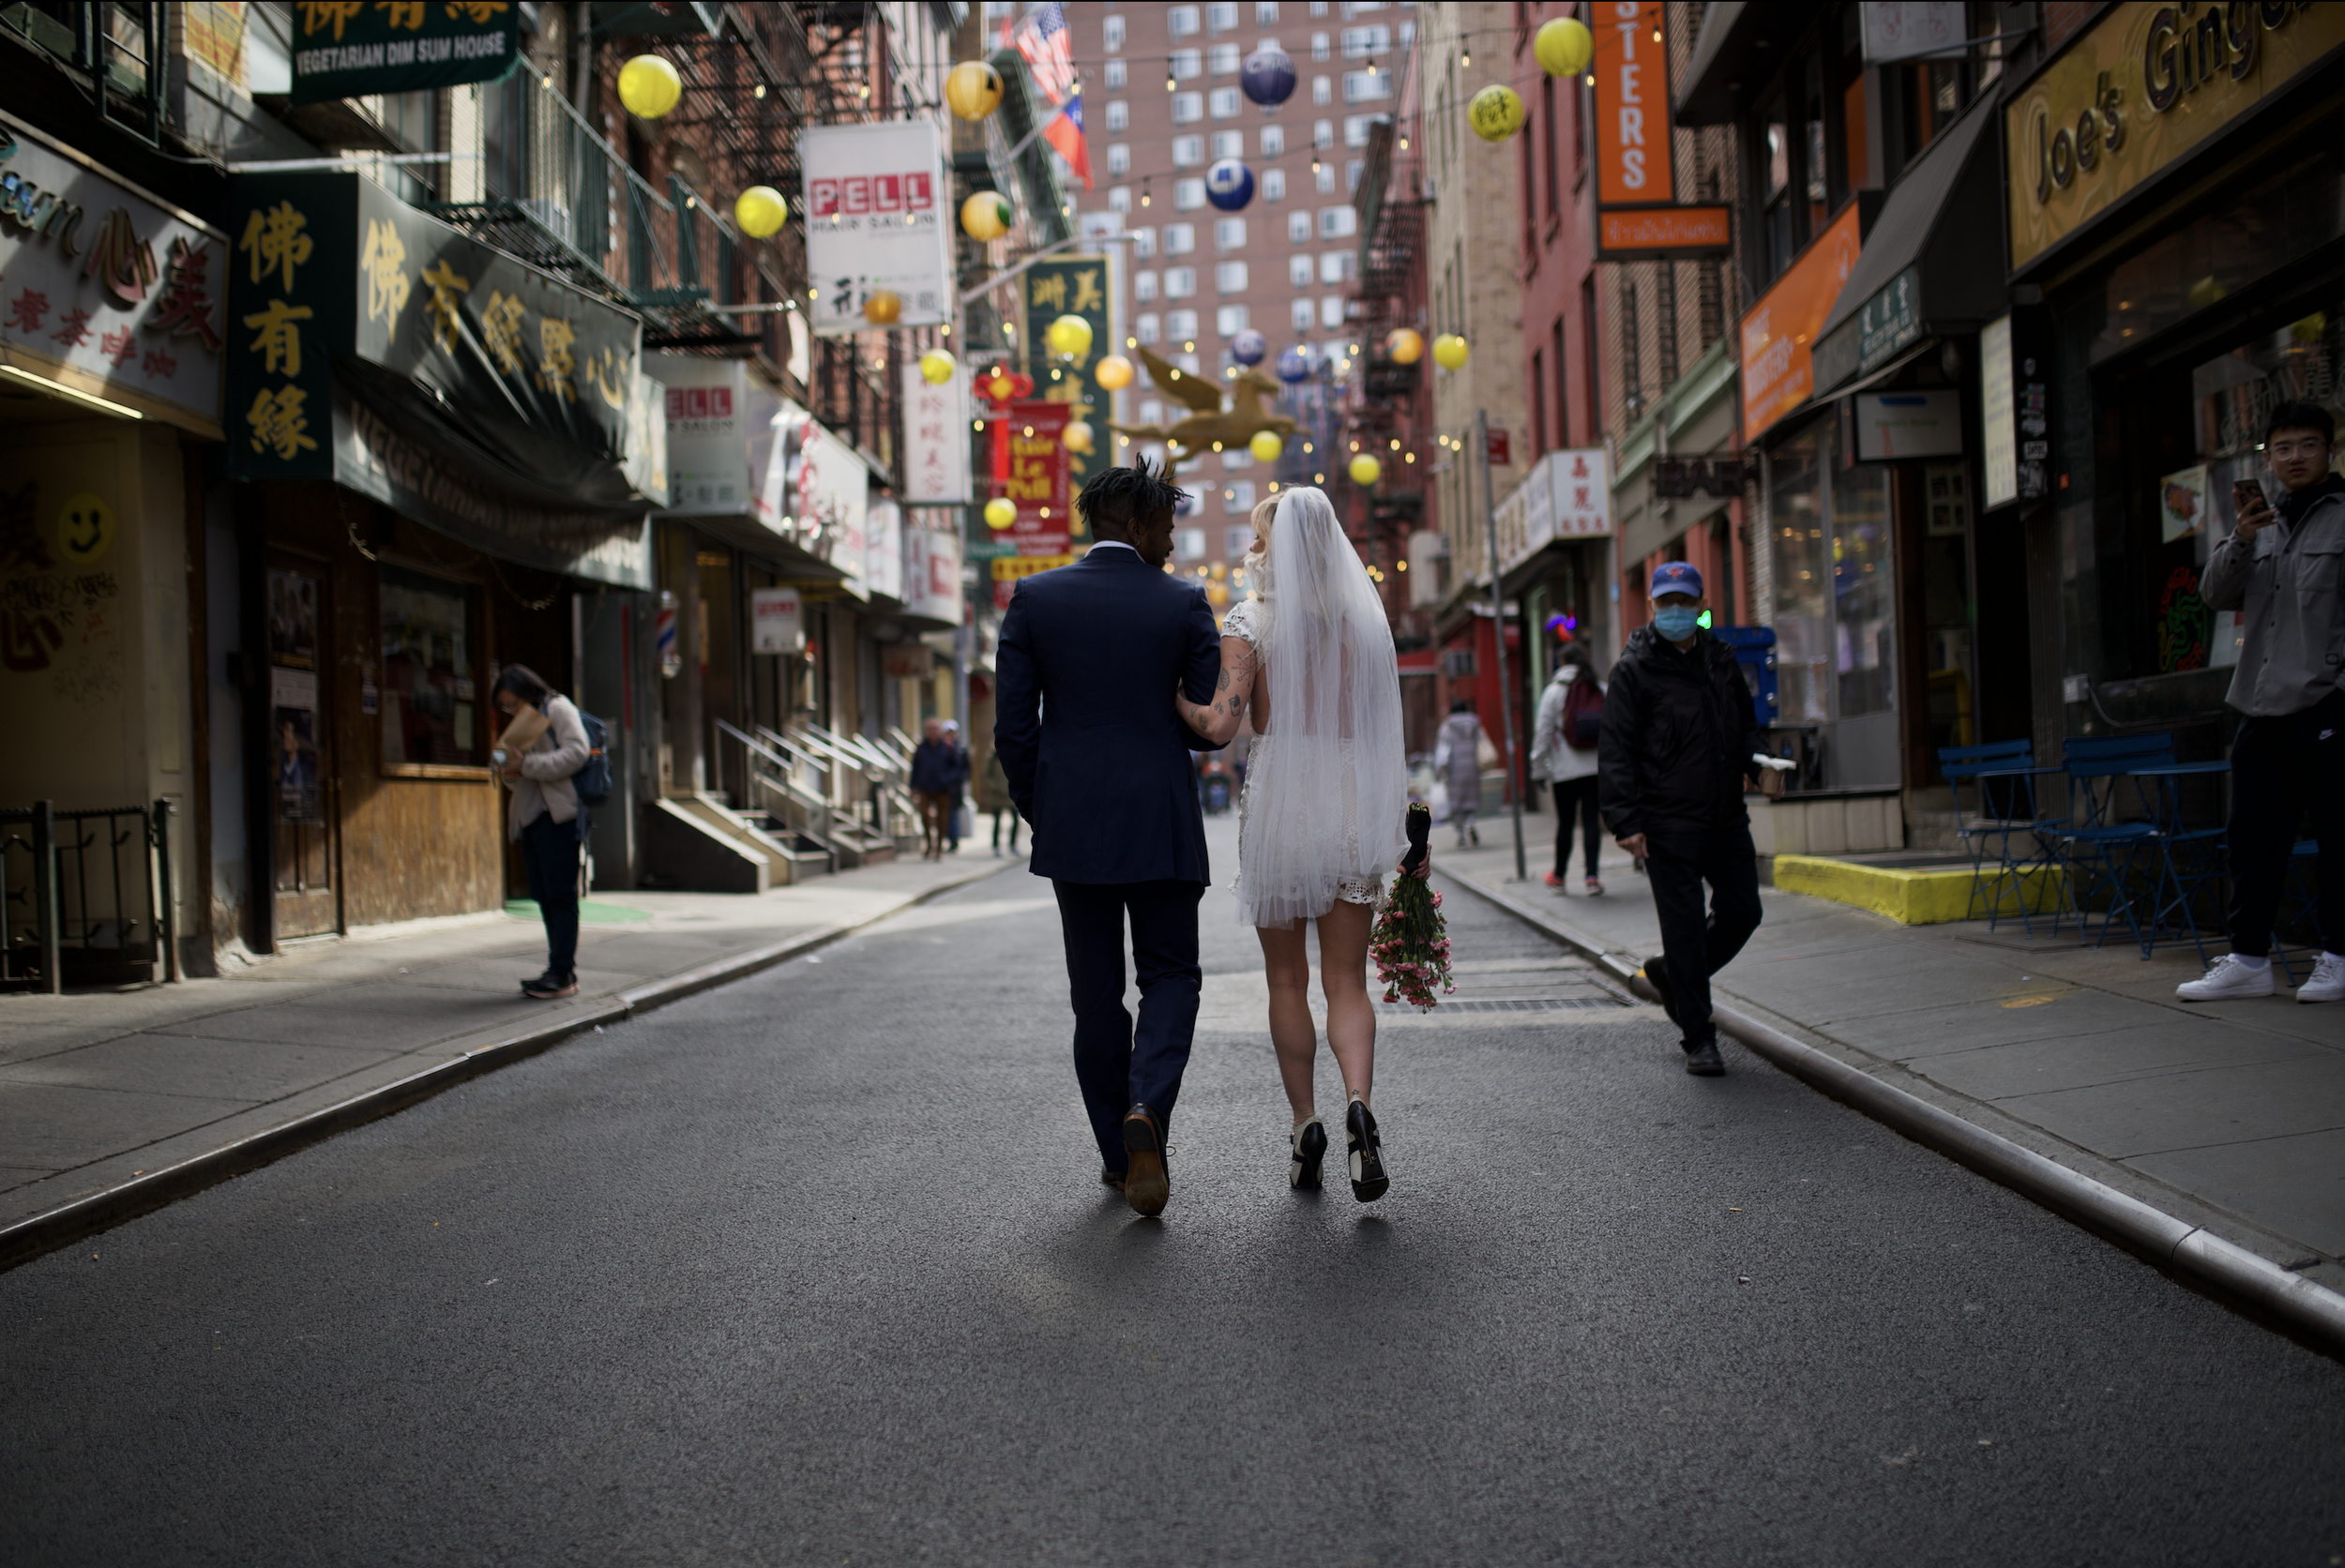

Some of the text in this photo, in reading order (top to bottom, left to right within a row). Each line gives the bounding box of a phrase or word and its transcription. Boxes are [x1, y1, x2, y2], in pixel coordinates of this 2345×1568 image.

[295, 30, 507, 76] VEGETARIAN DIM SUM HOUSE
[2036, 2, 2306, 206] Joe's Ging
[813, 173, 930, 215] PELL
[239, 200, 318, 460] 佛有緣
[666, 389, 730, 417] ELL
[681, 418, 734, 432] SALON
[1657, 461, 1746, 497] BAR
